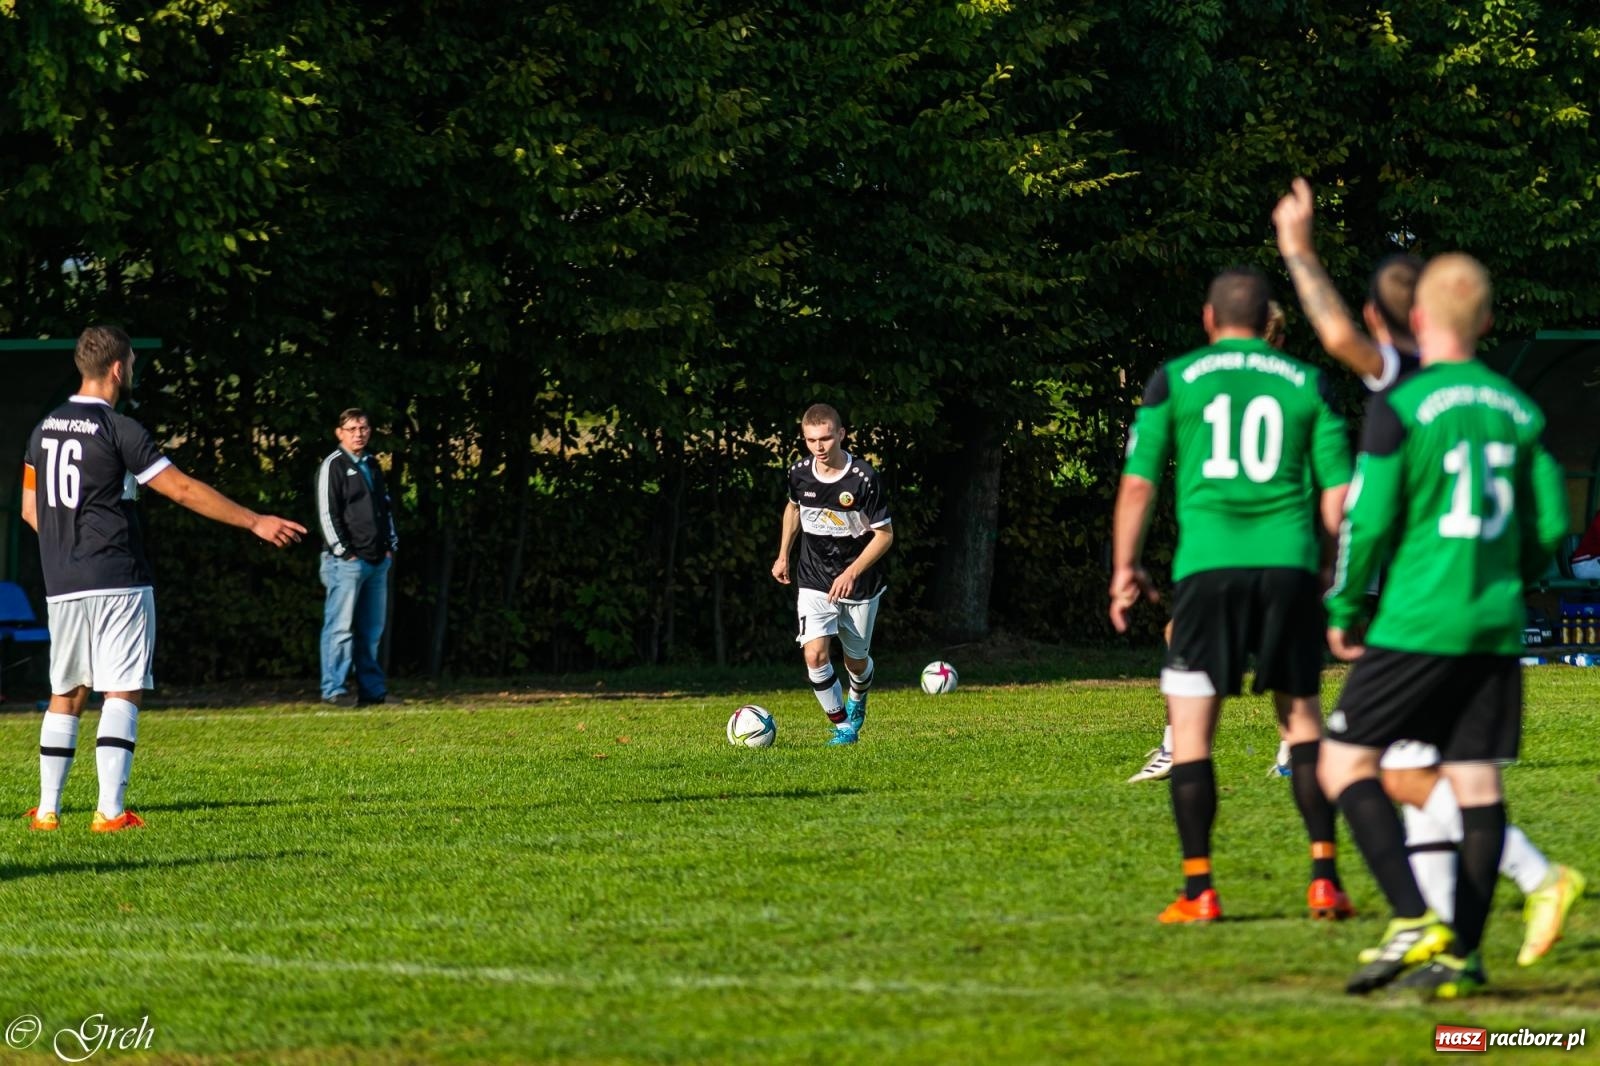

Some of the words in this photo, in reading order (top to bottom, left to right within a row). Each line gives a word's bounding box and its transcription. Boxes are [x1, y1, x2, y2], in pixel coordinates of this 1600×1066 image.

[41, 437, 82, 509] 16
[1202, 393, 1284, 483] 10
[1438, 440, 1516, 541] 15
